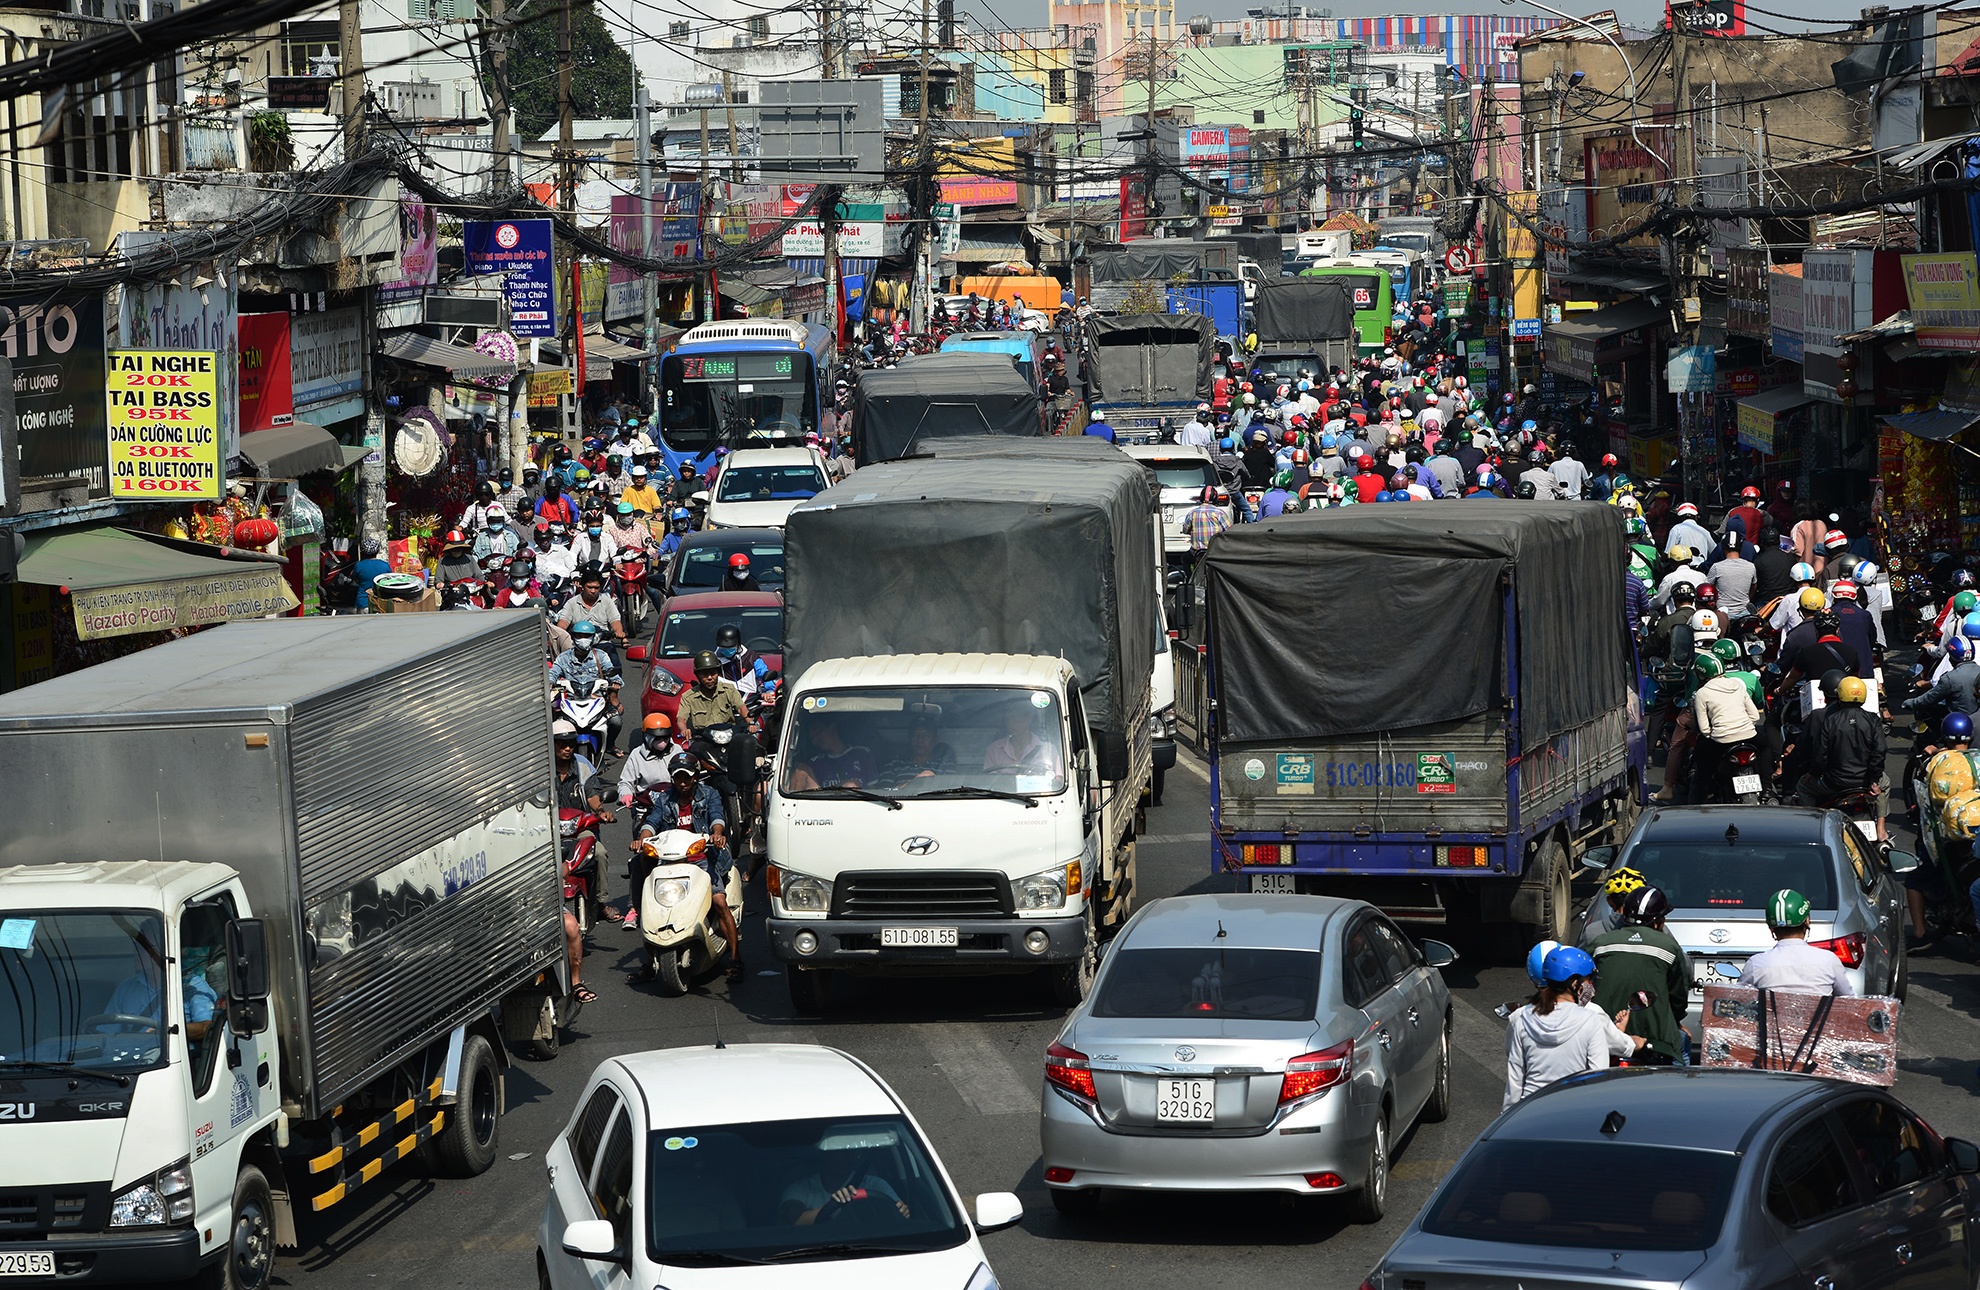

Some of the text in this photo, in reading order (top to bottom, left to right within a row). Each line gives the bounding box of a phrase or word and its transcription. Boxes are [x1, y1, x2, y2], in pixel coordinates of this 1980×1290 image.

[1191, 130, 1225, 145] CAMERA
[509, 282, 529, 290] Thanh
[1356, 290, 1368, 302] 65
[108, 356, 211, 372] TAI NGHE
[683, 358, 705, 377] 27
[29, 375, 59, 393] LƯỢNG
[127, 374, 192, 386] 20K
[1736, 373, 1755, 383] DÉP
[109, 391, 211, 407] TAI BASS
[22, 404, 73, 431] CÔNG NGHỆ
[127, 408, 193, 420] 95K
[111, 422, 212, 446] DÁN CƯỜNG LỰC
[129, 446, 194, 457] 30K
[112, 461, 213, 478] LOA BLUETOOTH
[121, 479, 203, 491] 160K
[205, 580, 227, 596] KIỆN
[190, 596, 290, 621] Hazatomobile.com
[83, 605, 177, 632] Hazato Party
[1280, 764, 1311, 775] CRB
[1455, 761, 1488, 771] THACO
[794, 818, 834, 826] HYUNDAI
[1261, 874, 1285, 889] 51C
[883, 928, 955, 945] 51D-081.55
[1170, 1082, 1202, 1099] 51G
[78, 1101, 123, 1113] QKR
[1159, 1100, 1213, 1119] 329.62
[195, 1120, 214, 1138] ISUZU
